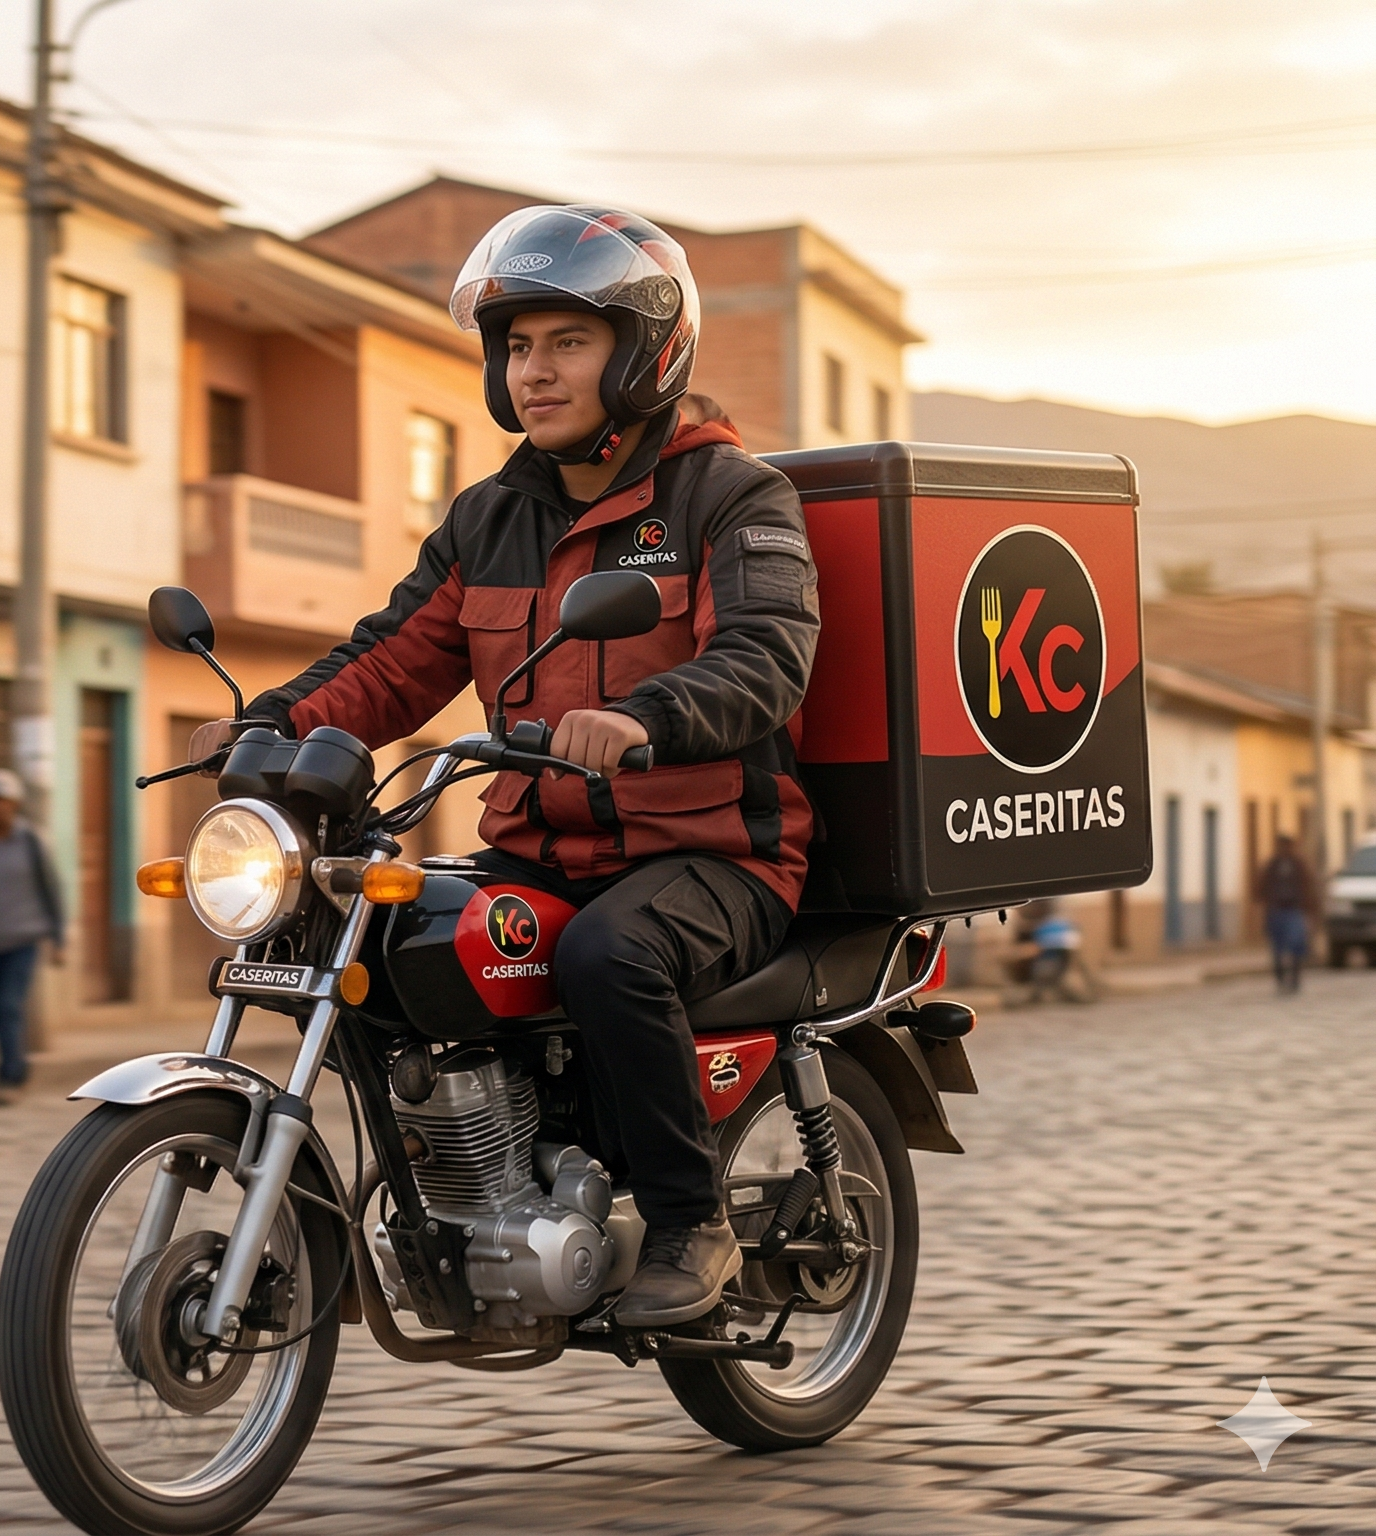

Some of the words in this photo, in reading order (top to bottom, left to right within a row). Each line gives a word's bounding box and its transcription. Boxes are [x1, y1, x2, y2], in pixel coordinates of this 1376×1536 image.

[618, 552, 677, 567] CASERITAS
[946, 785, 1125, 843] CASERITAS
[229, 967, 299, 985] CASERITAS
[482, 963, 549, 979] CASERITAS
